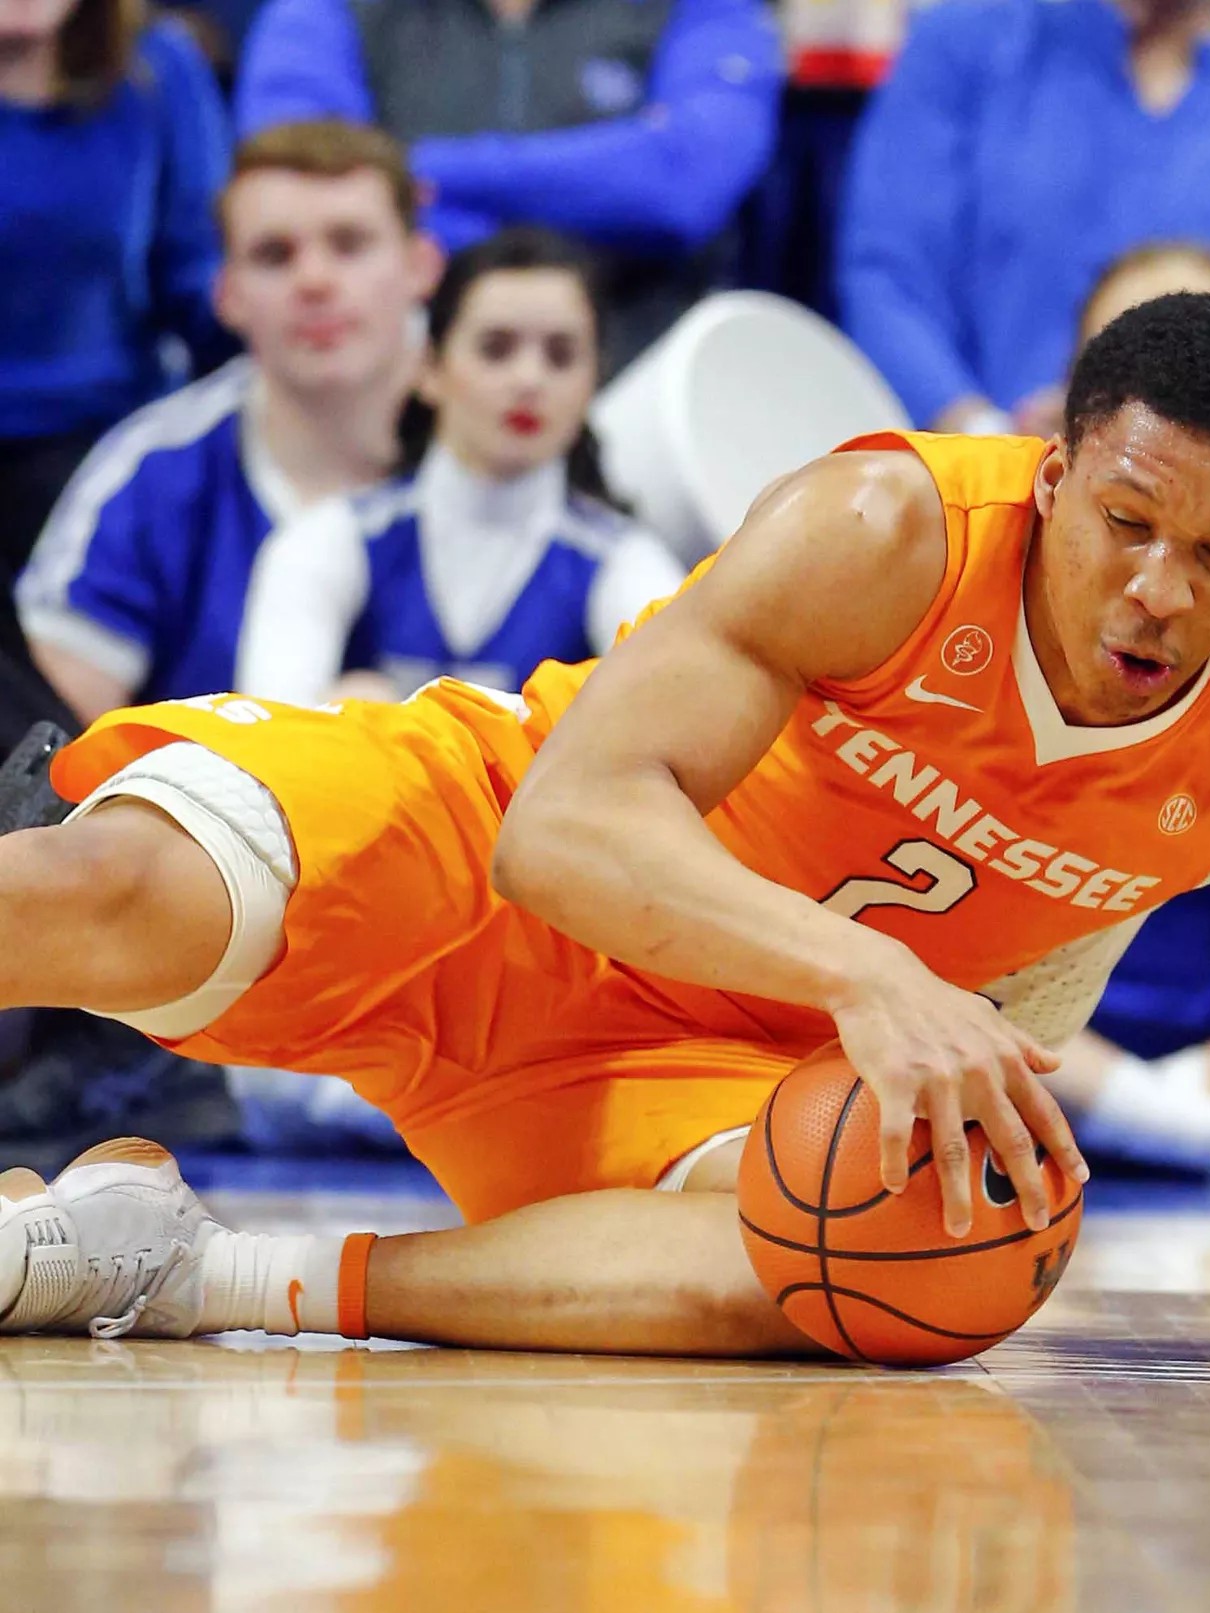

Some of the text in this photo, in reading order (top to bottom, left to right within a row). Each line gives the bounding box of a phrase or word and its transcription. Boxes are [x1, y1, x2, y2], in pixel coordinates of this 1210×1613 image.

[811, 700, 1162, 912] TENNESSEE
[1162, 797, 1193, 832] SEC
[818, 837, 978, 919] 2
